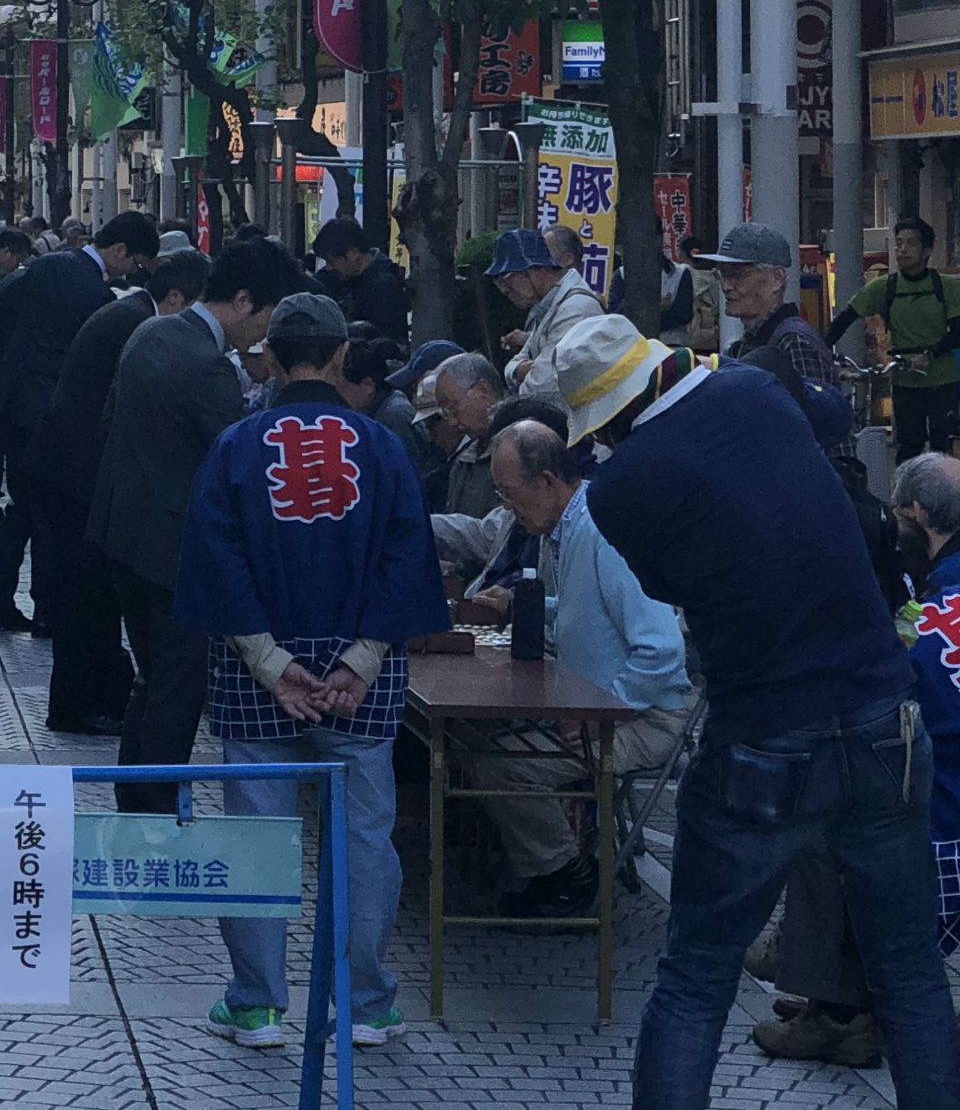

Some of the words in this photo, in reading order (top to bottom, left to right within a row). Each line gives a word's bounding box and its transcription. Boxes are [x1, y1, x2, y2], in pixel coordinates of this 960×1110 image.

[262, 414, 361, 524] 碁
[11, 788, 47, 970] 午後6時まで
